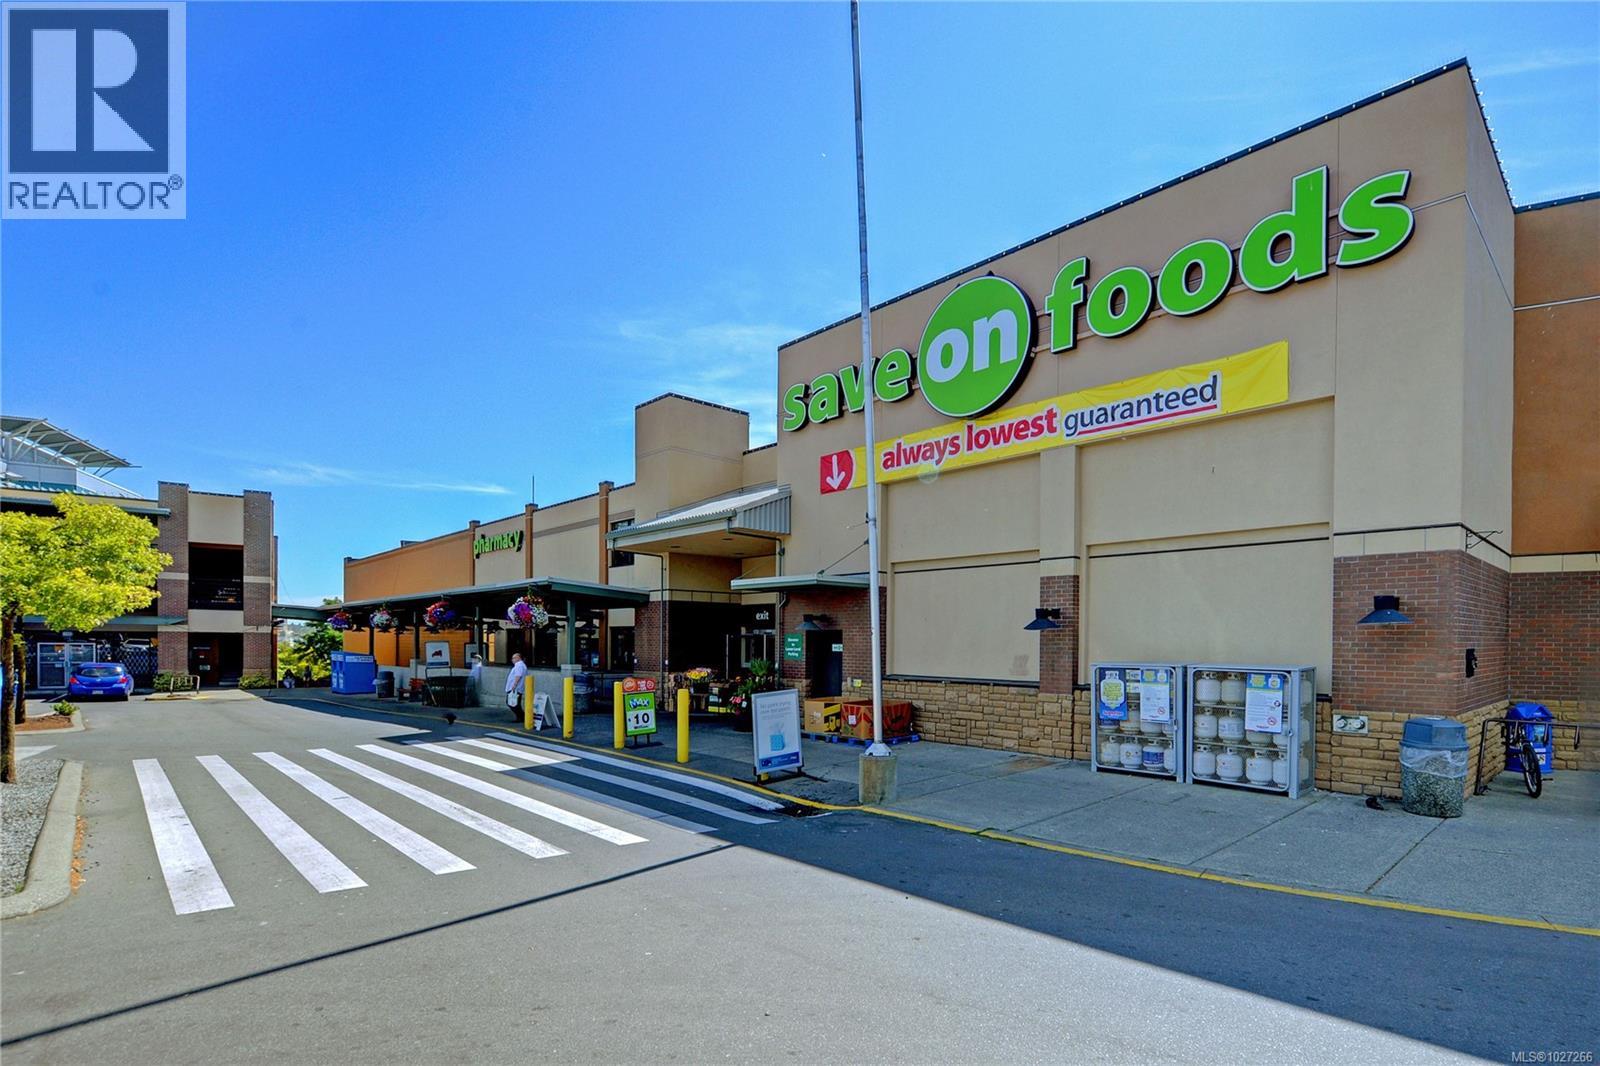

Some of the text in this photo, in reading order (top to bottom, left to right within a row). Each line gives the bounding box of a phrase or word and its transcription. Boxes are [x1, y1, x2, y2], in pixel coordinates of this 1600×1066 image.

[783, 165, 1415, 432] save on foods
[882, 374, 1217, 467] always lowest guaranteed
[473, 530, 522, 559] pharmacy
[755, 610, 769, 621] exit
